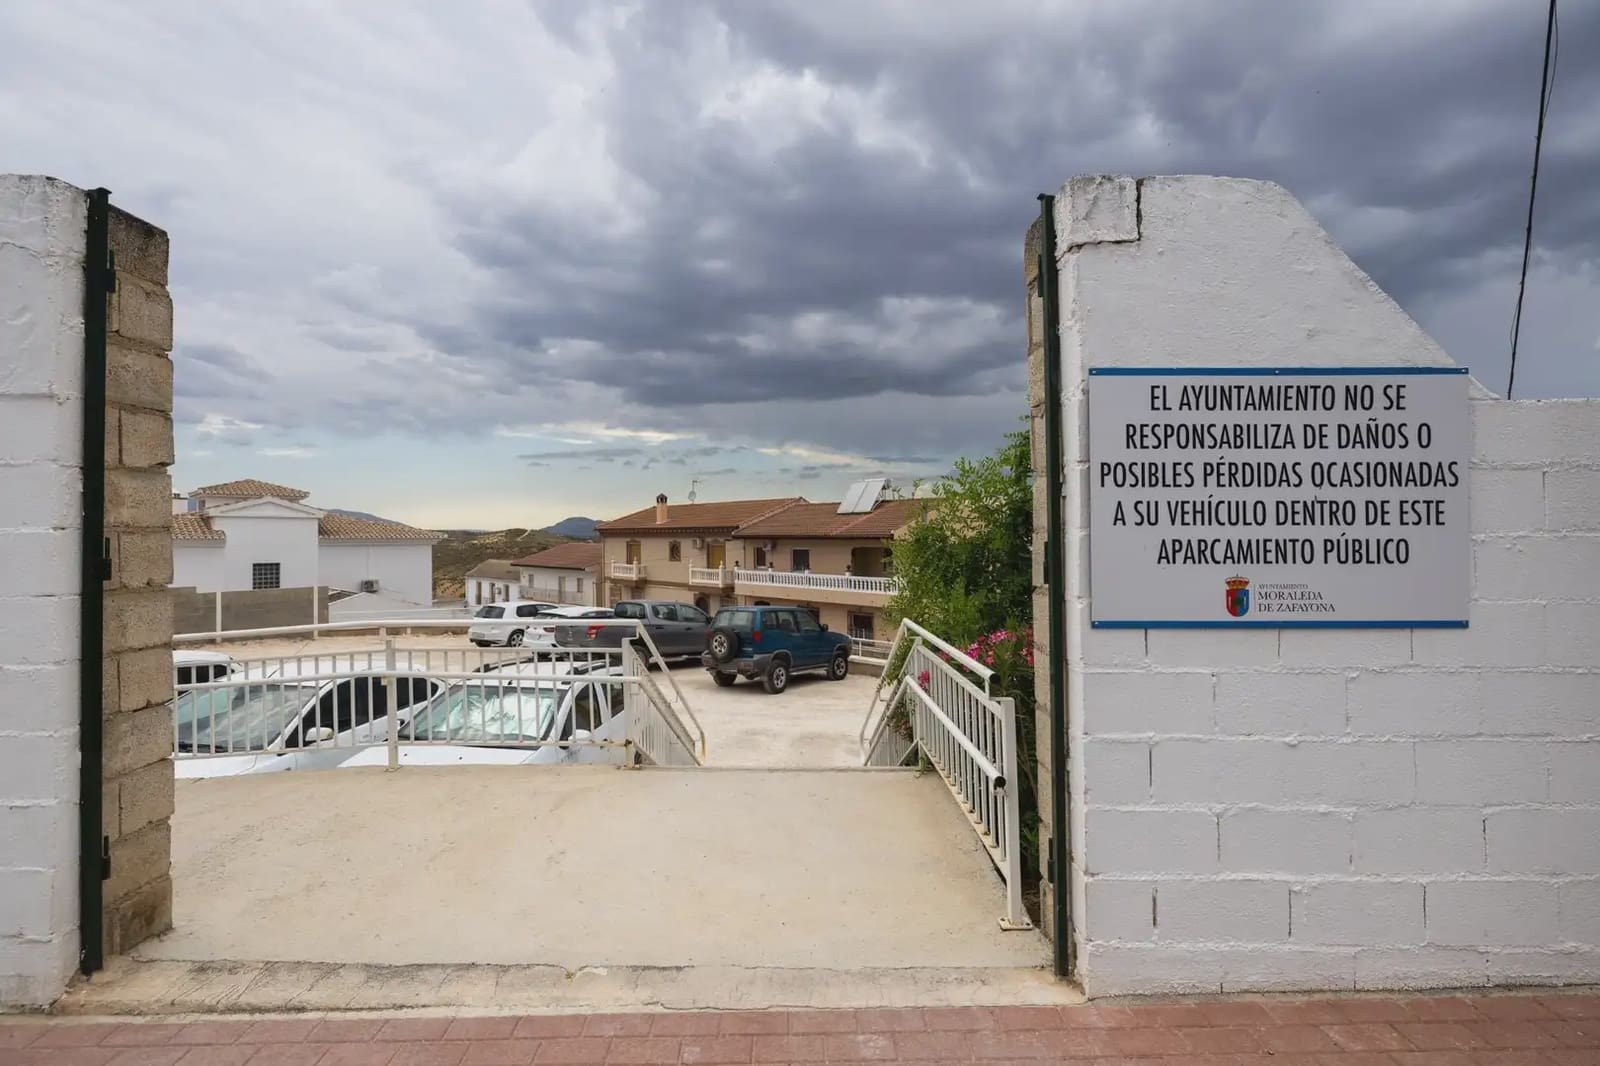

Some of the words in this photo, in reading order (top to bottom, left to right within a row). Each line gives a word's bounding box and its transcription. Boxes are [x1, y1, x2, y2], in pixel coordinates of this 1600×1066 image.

[1151, 384, 1172, 411] EL
[1178, 384, 1335, 411] AYUNTAMIENTO
[1344, 384, 1375, 411] NO
[1382, 384, 1407, 411] SE
[1125, 423, 1297, 449] RESPONSABILIZA
[1303, 423, 1329, 449] DE
[1336, 417, 1409, 449] DAÑOS
[1417, 423, 1432, 449] O
[1100, 462, 1194, 488] POSIBLES
[1202, 455, 1303, 488] PÉRDIDAS
[1311, 461, 1460, 489] OCASIONADAS
[1113, 500, 1127, 526] A
[1134, 500, 1159, 526] SU
[1167, 494, 1267, 526] VEHÍCULO
[1275, 499, 1357, 526] DENTRO
[1365, 500, 1391, 526] DE
[1399, 500, 1446, 526] ESTE
[1156, 538, 1315, 565] APARCAMIENTO
[1323, 531, 1410, 565] PÚBLICO
[1258, 591, 1323, 600] MORALEDA
[1258, 603, 1274, 612] DE
[1276, 603, 1336, 612] ZAFAYONA
